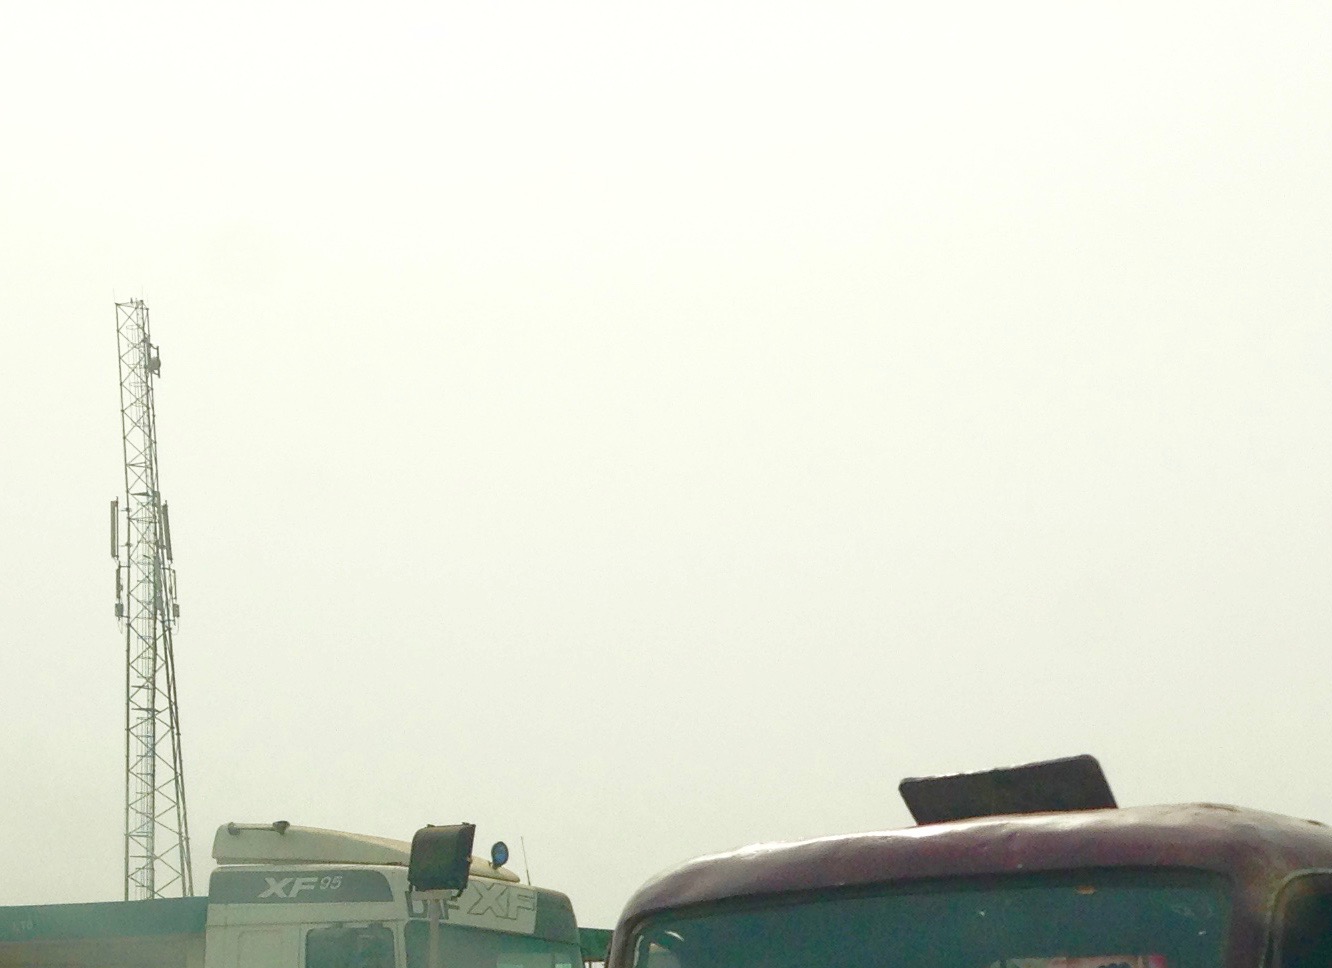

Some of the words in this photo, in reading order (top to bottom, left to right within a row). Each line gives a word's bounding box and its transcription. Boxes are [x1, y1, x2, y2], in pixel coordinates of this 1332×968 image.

[258, 877, 319, 899] XF
[320, 875, 343, 890] 95
[466, 880, 537, 921] XF
